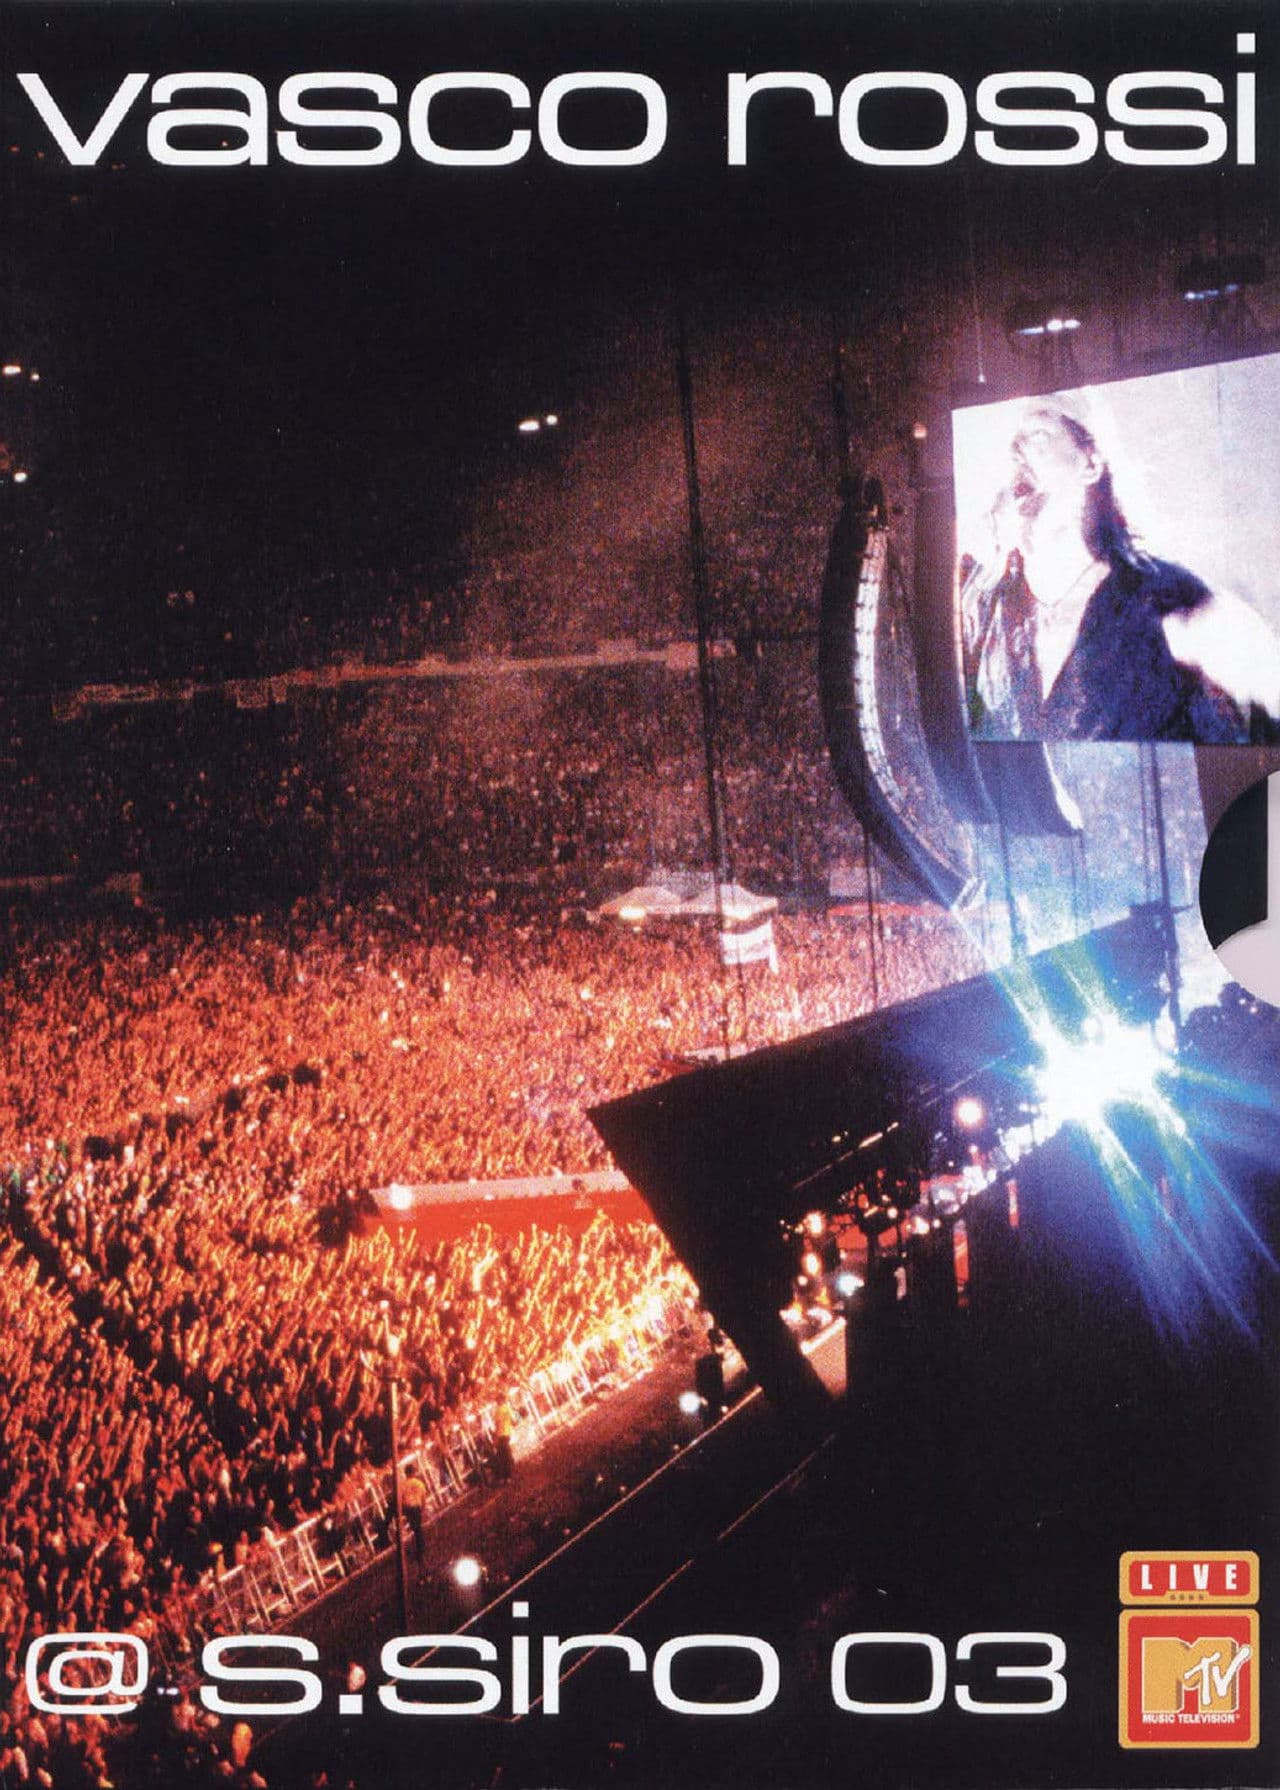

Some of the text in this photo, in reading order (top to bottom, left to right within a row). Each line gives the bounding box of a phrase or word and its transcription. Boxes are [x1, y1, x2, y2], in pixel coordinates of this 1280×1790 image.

[17, 32, 1256, 166] vasco rossi
[1141, 1563, 1237, 1590] LIVE
[24, 1601, 1067, 1717] @ s.siro 03
[1142, 1637, 1253, 1713] MTV
[1142, 1713, 1175, 1724] MUSIC
